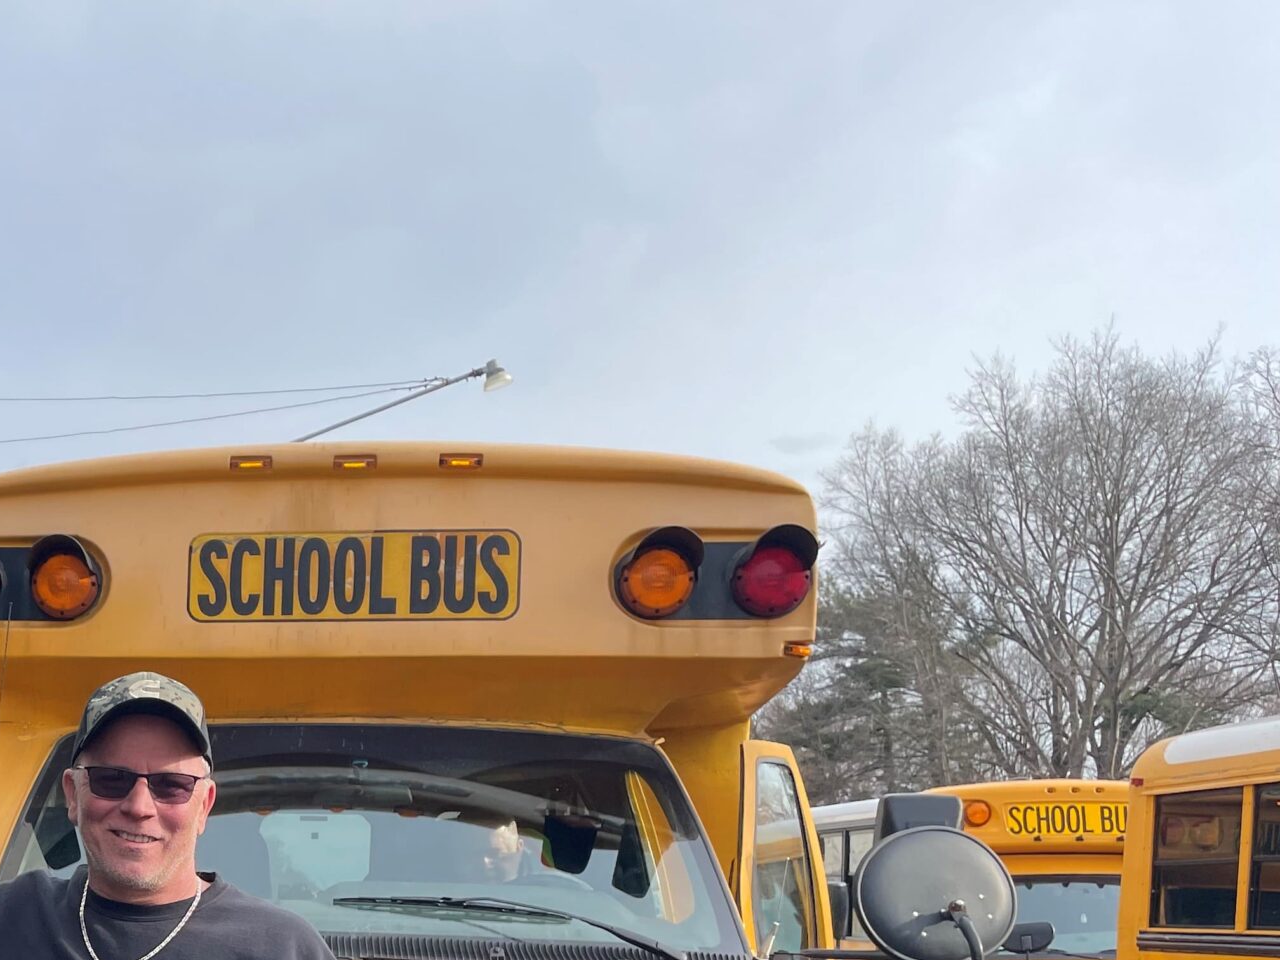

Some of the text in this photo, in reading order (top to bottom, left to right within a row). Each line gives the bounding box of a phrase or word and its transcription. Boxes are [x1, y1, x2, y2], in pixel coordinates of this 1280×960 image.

[197, 535, 510, 617] SCHOOL BUS
[1008, 805, 1128, 835] SCHOOL BU
